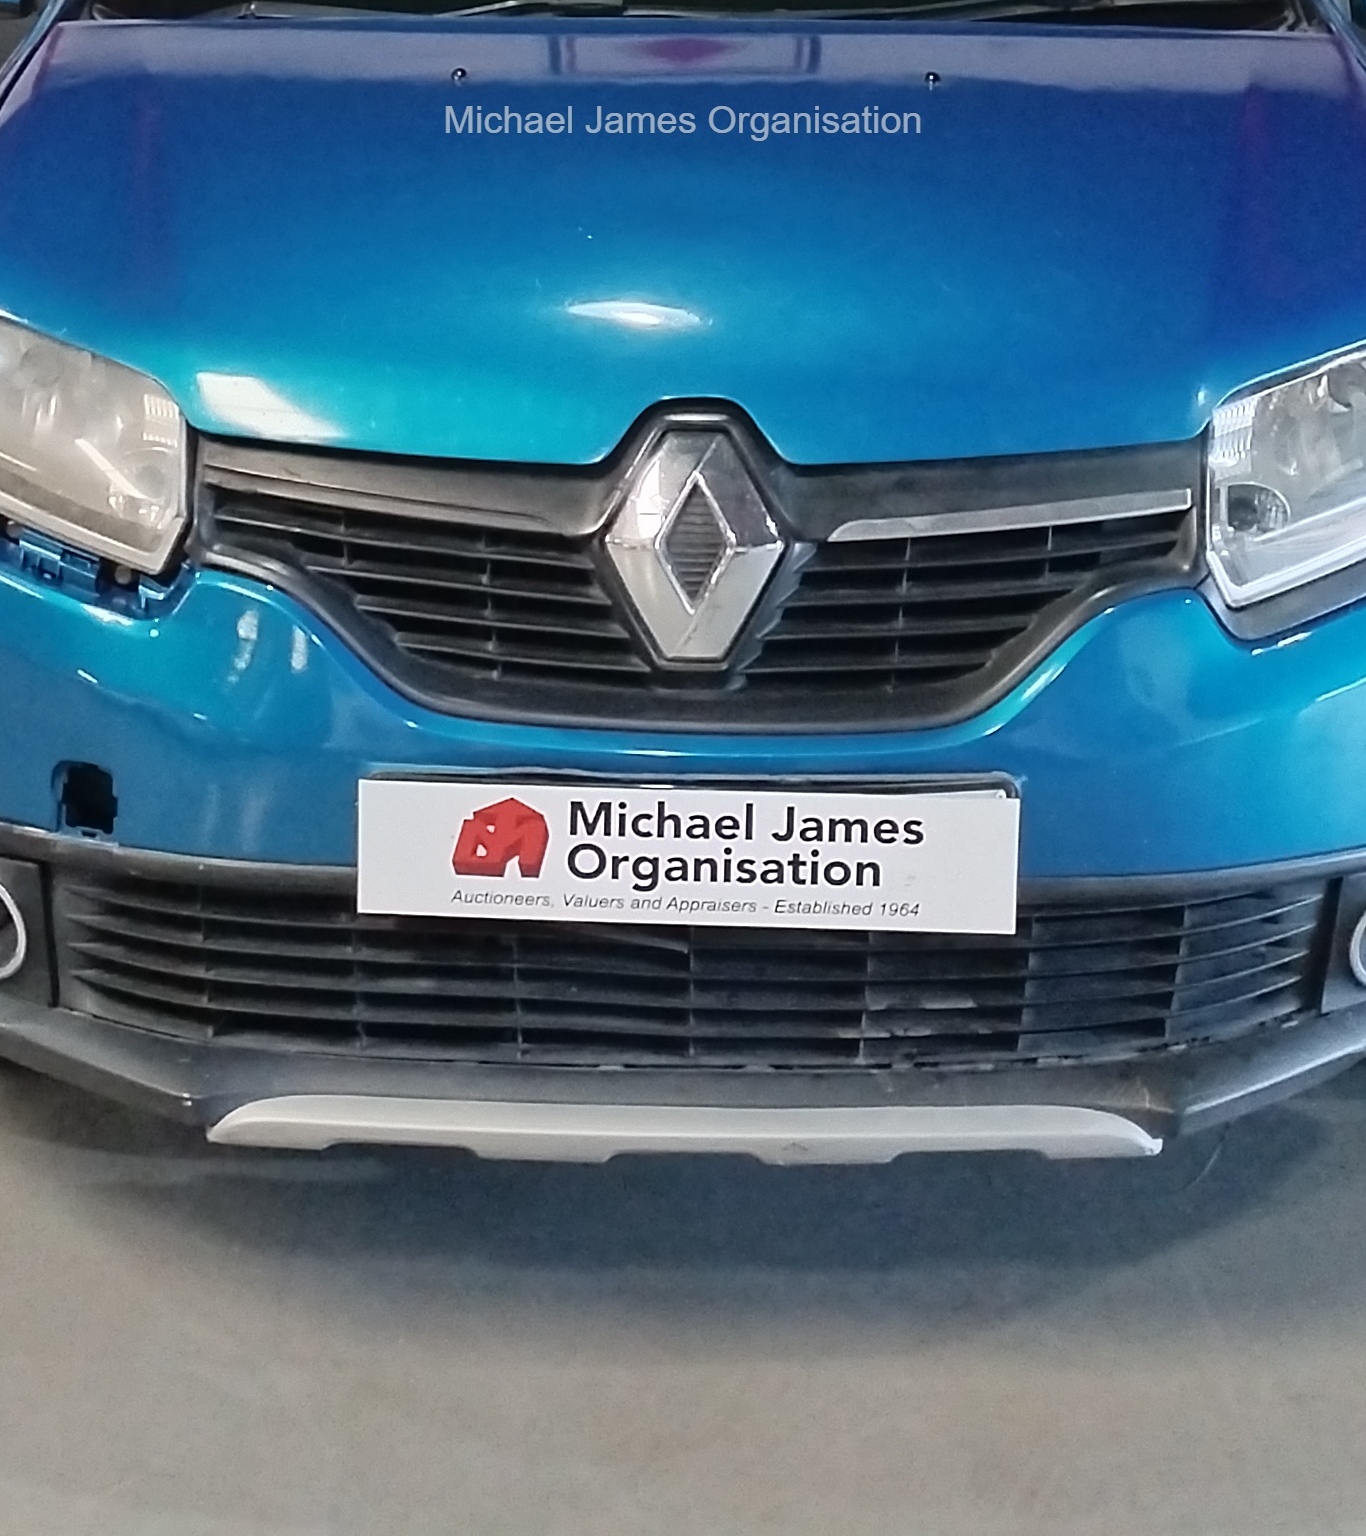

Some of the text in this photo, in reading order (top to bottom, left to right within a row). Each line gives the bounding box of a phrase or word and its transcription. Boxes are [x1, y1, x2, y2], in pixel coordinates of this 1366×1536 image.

[570, 801, 923, 844] Michael James
[568, 844, 880, 891] Organisation
[451, 890, 555, 909] Auctioneers,
[564, 894, 624, 909] Valuers
[631, 897, 662, 909] and
[666, 897, 756, 913] Appraisers
[775, 900, 873, 915] Established
[881, 903, 919, 916] 1964
